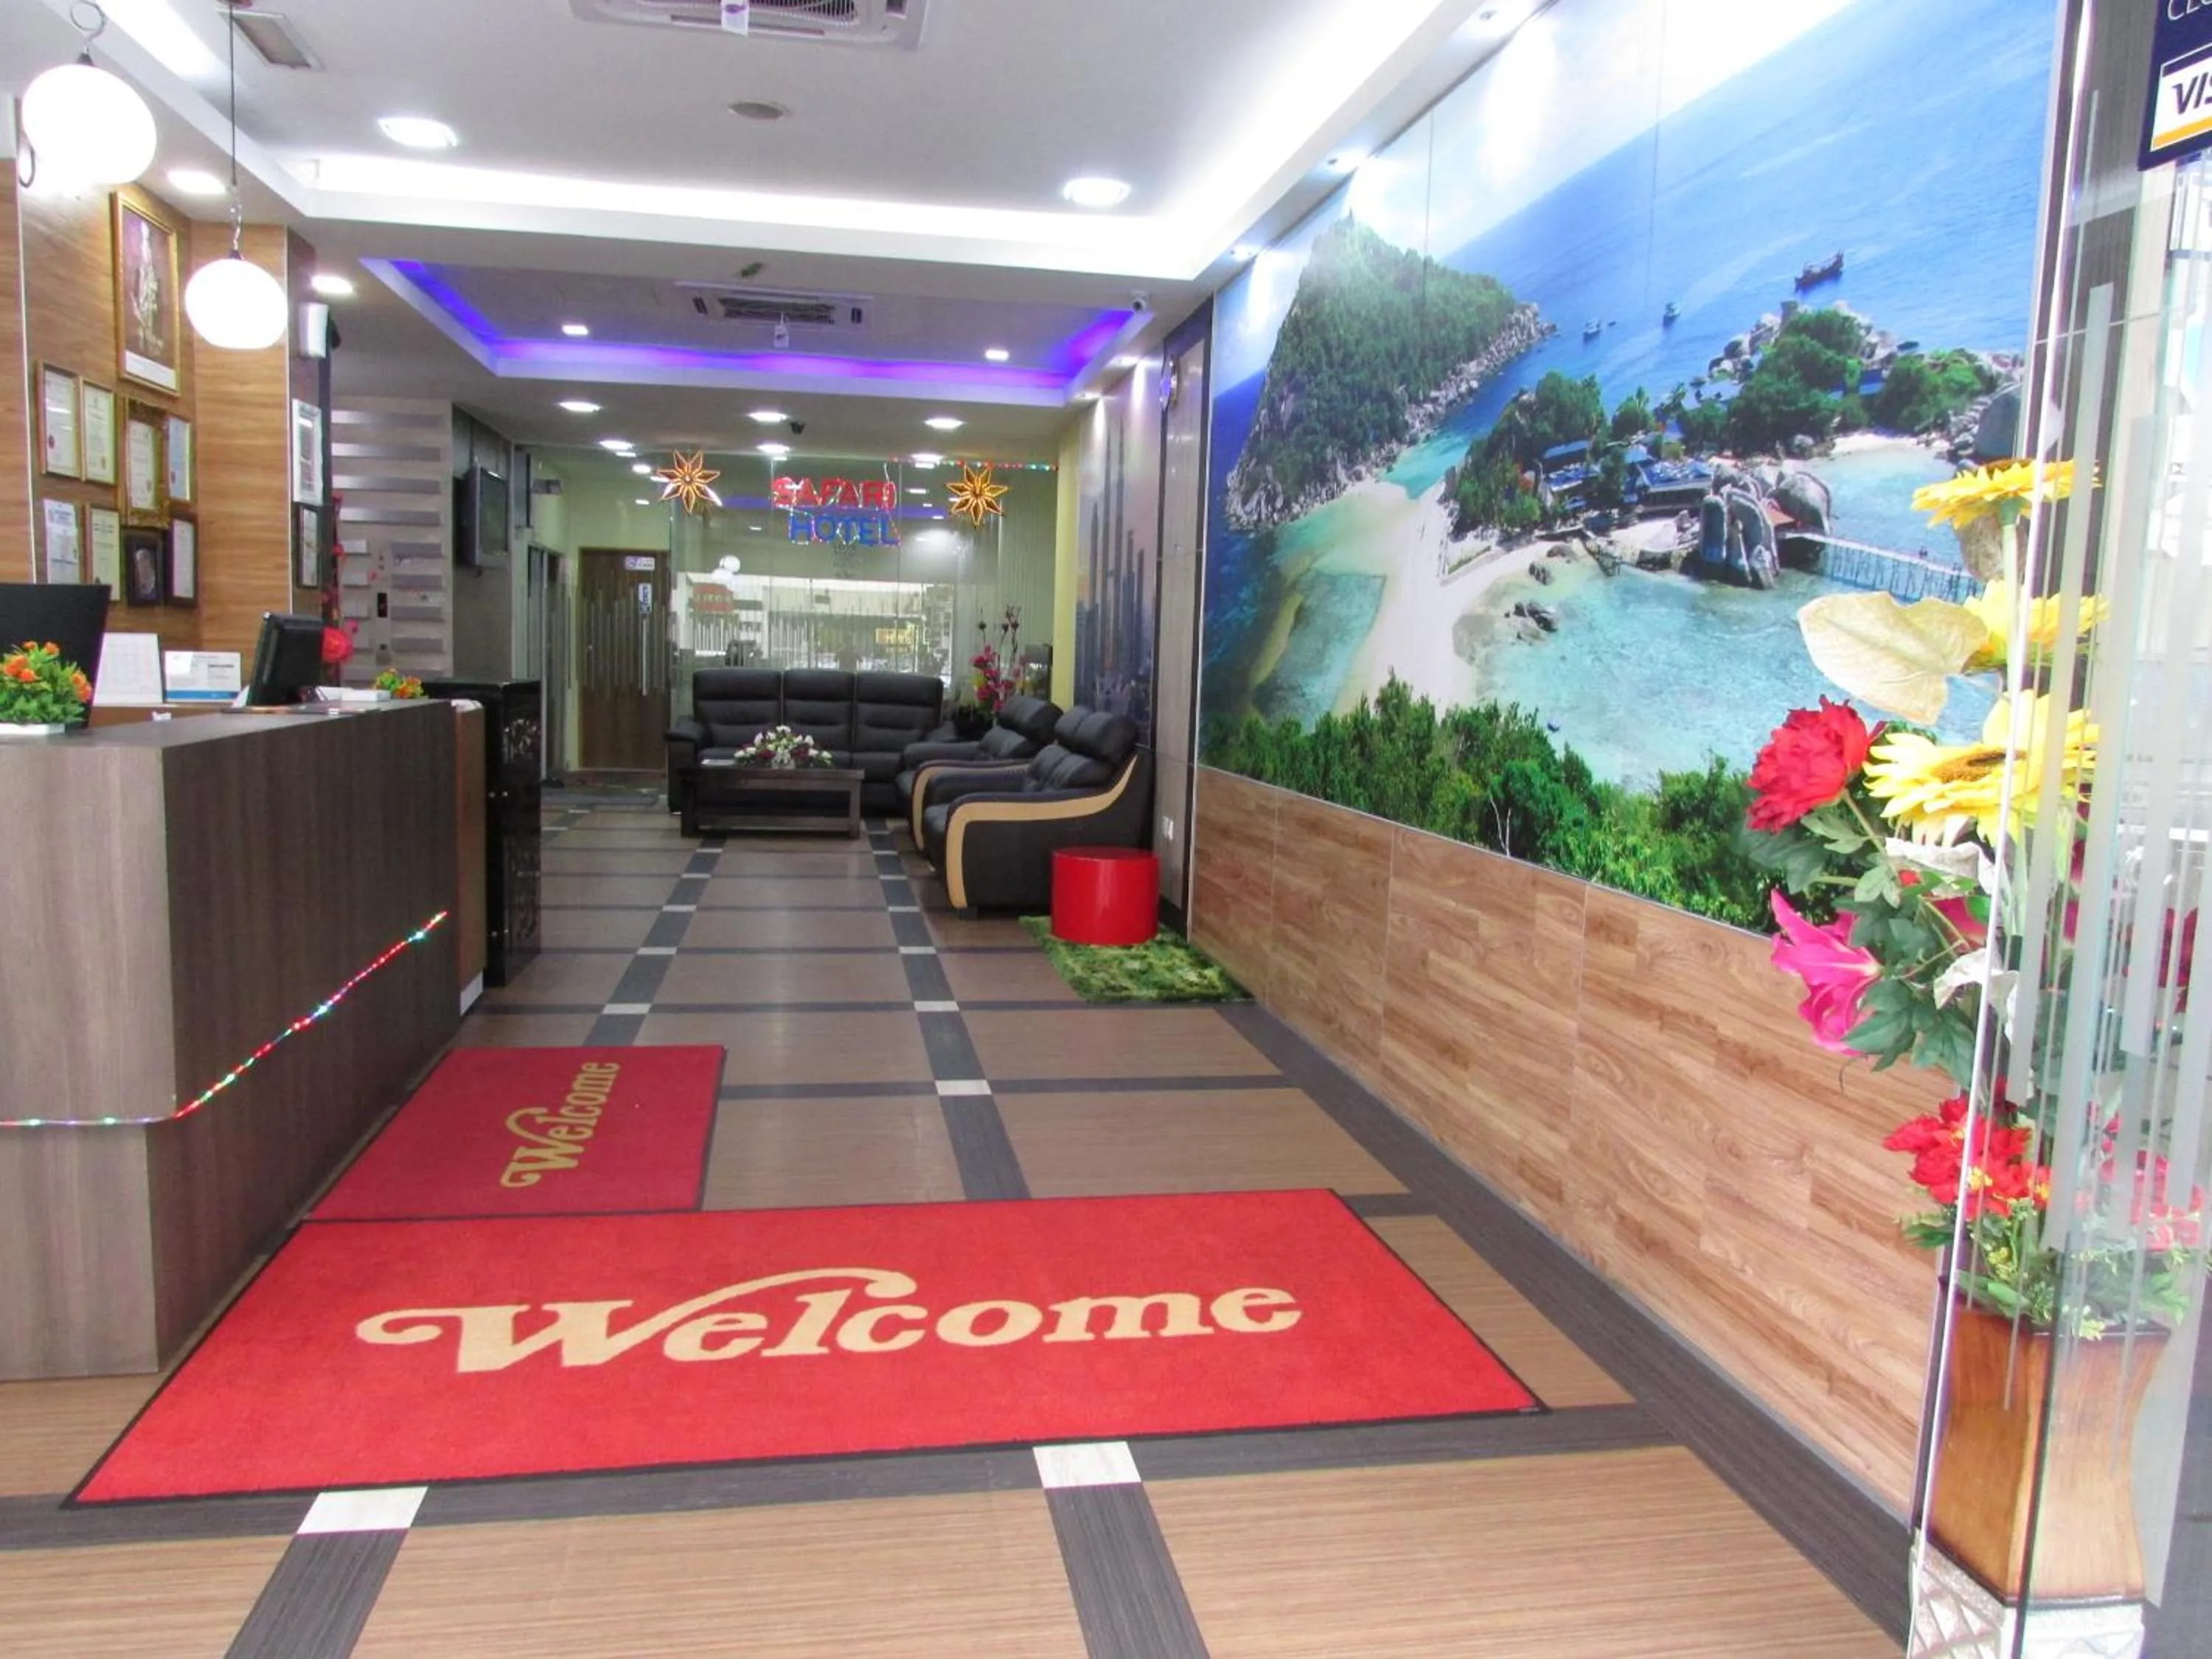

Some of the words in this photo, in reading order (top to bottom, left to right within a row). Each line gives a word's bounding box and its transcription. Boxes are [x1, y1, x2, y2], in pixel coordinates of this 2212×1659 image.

[772, 477, 897, 509] SAFARI
[788, 515, 901, 546] HOTEL
[500, 1062, 620, 1187] Welcome
[356, 1267, 1301, 1374] Welcome
